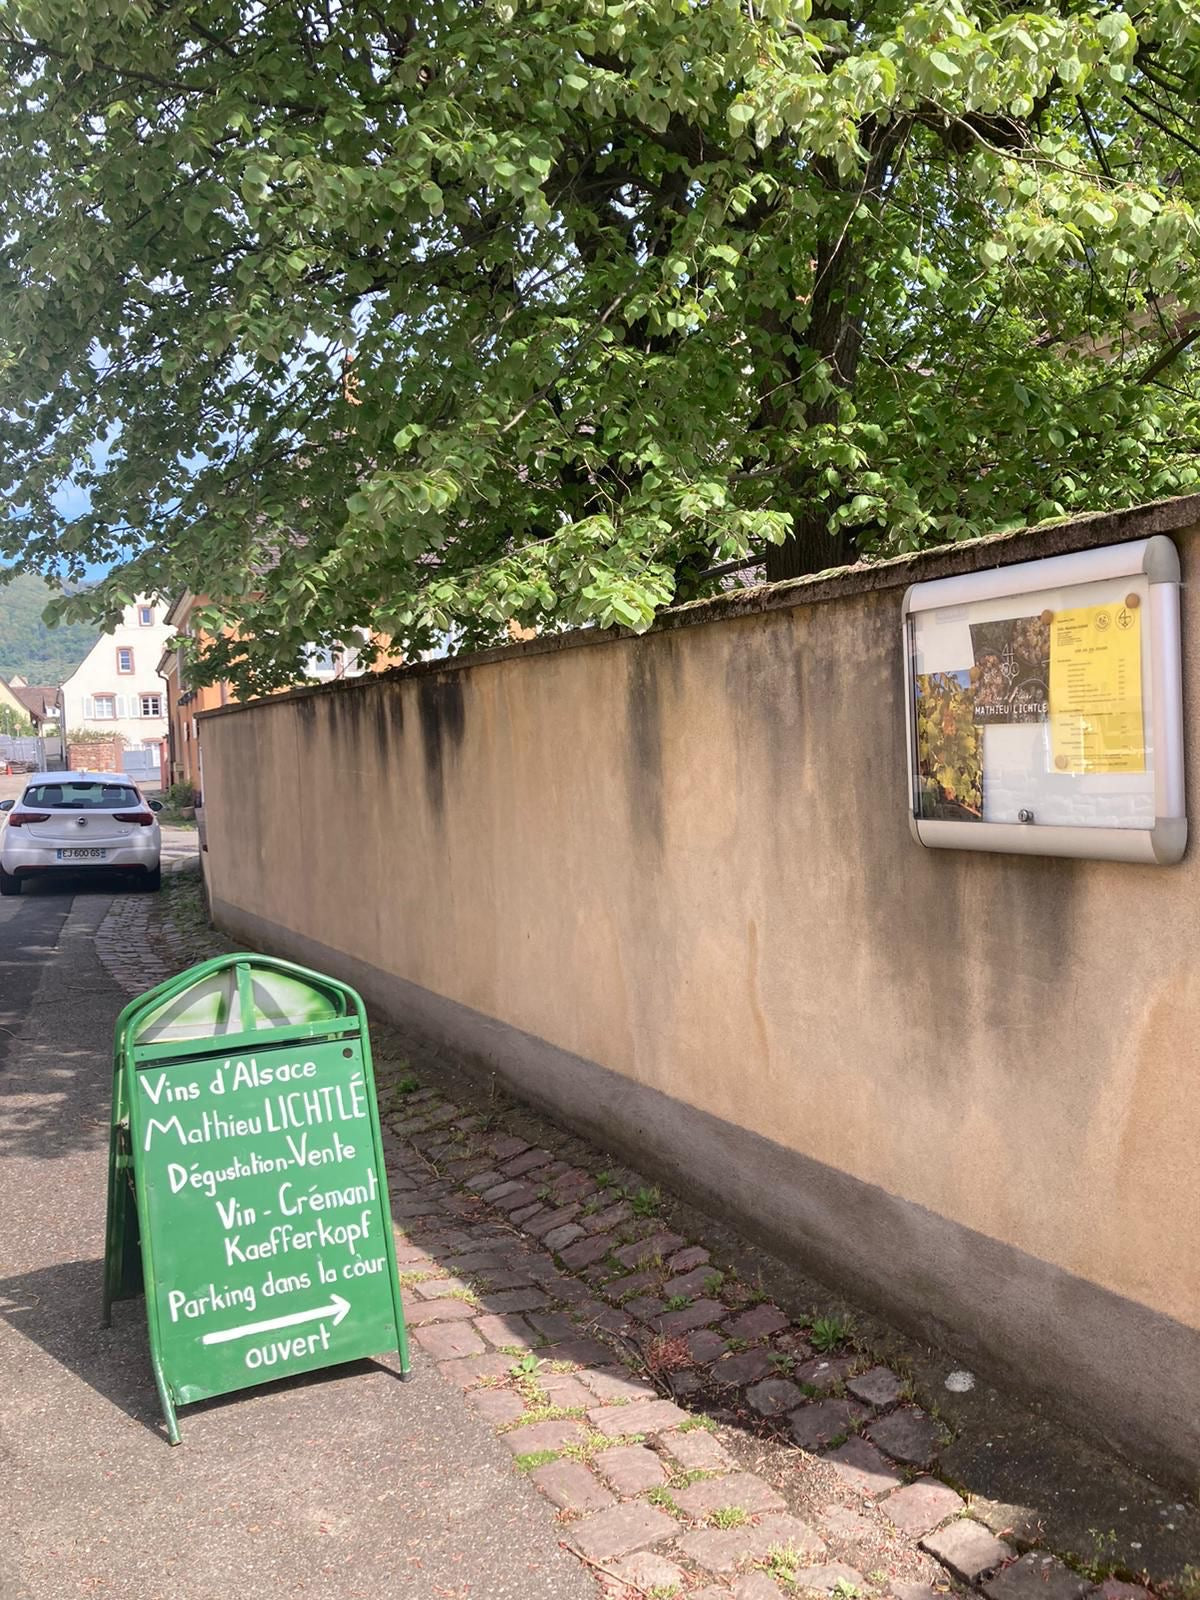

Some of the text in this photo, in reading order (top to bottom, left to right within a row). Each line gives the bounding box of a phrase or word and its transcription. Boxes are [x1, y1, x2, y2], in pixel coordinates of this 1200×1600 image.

[975, 704, 1009, 715] MATHIEU
[140, 1058, 317, 1105] Vins d'Alsace
[144, 1071, 367, 1151] Mathieu LICHTLÉ
[167, 1131, 357, 1197] Dégustation-Vente
[215, 1197, 256, 1230] Vin
[278, 1167, 378, 1216] Crémant
[224, 1209, 372, 1266] Kaefferkopf
[168, 1256, 386, 1322] Parking dans la cour
[244, 1322, 331, 1369] ouvert
